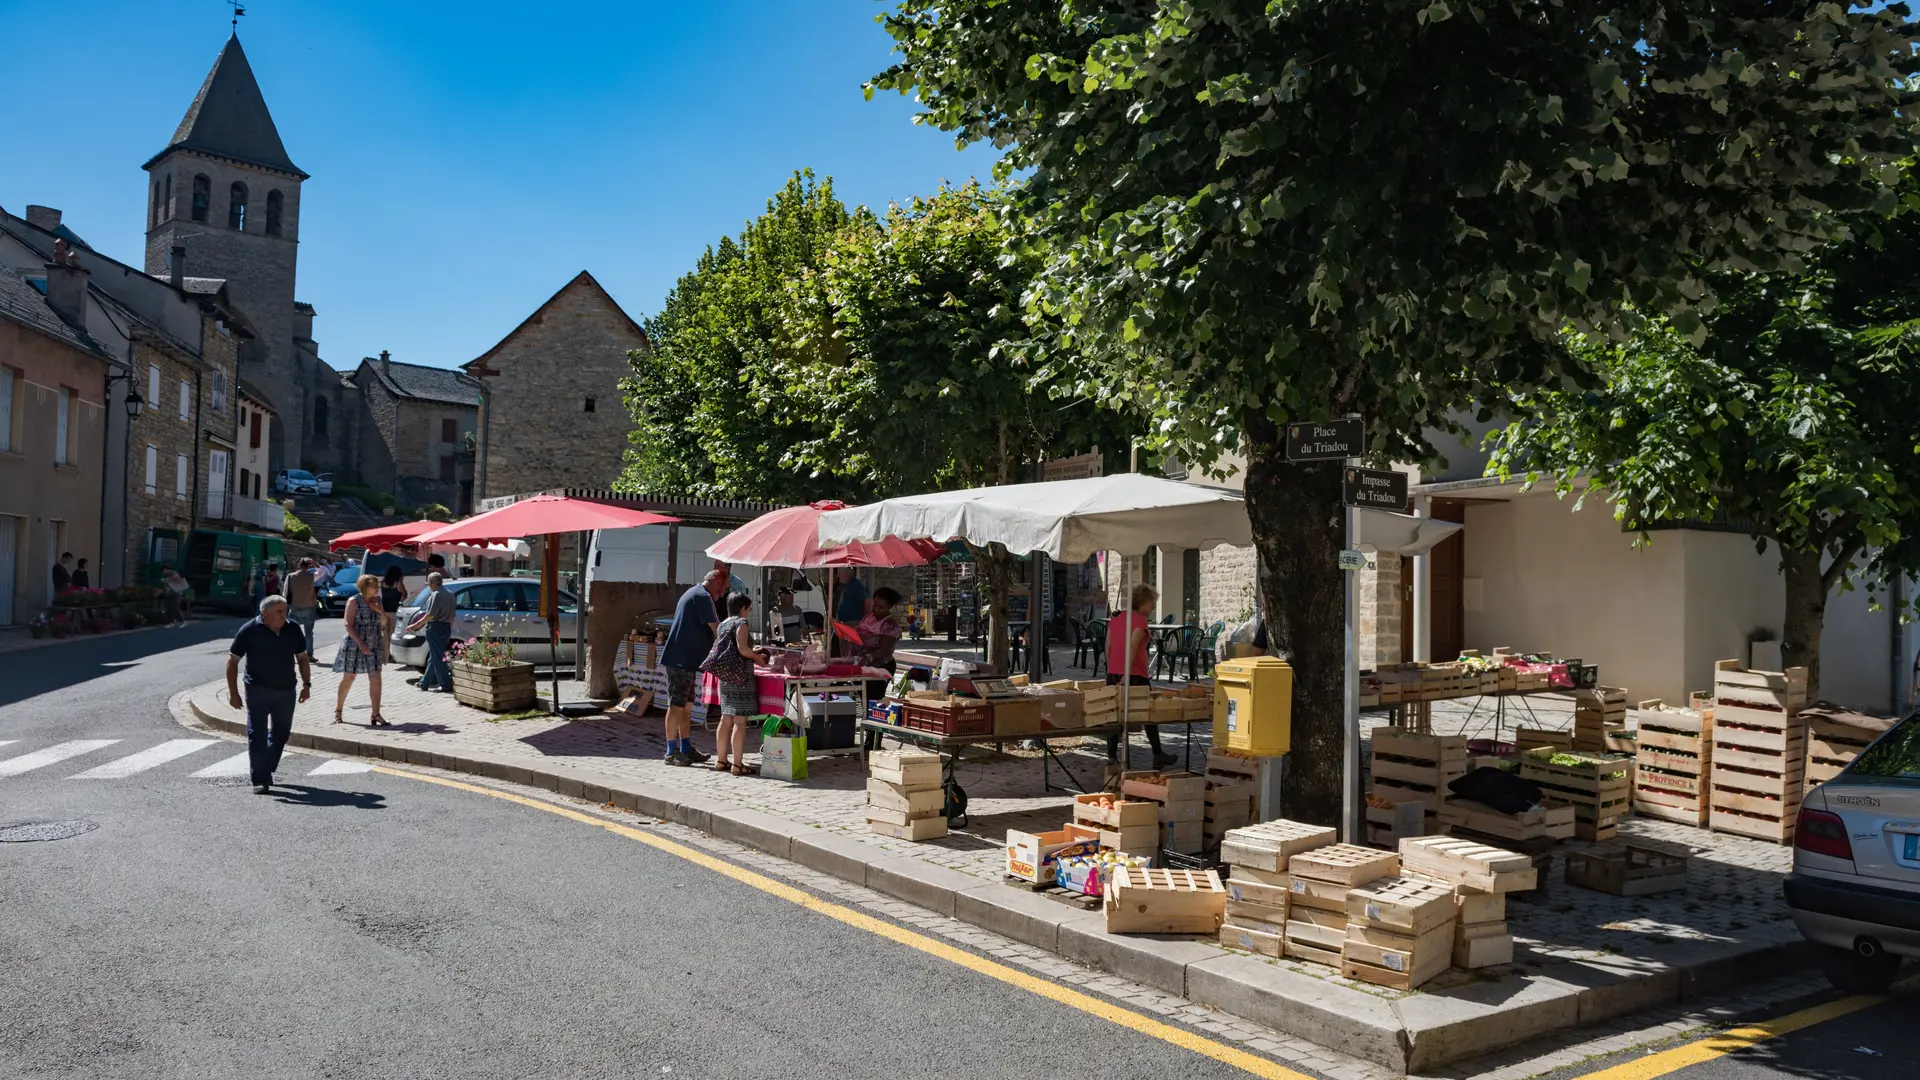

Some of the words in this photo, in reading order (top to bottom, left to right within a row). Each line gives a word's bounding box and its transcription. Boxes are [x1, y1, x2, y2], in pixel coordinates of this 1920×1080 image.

[1313, 426, 1337, 438] Place
[1301, 444, 1312, 453] du
[1314, 441, 1348, 452] Triadou
[1362, 474, 1391, 488] Impasse
[1356, 489, 1366, 500] du
[1367, 490, 1396, 503] Triadou
[1648, 773, 1687, 787] PROVENCE
[1837, 795, 1880, 806] CITROËN
